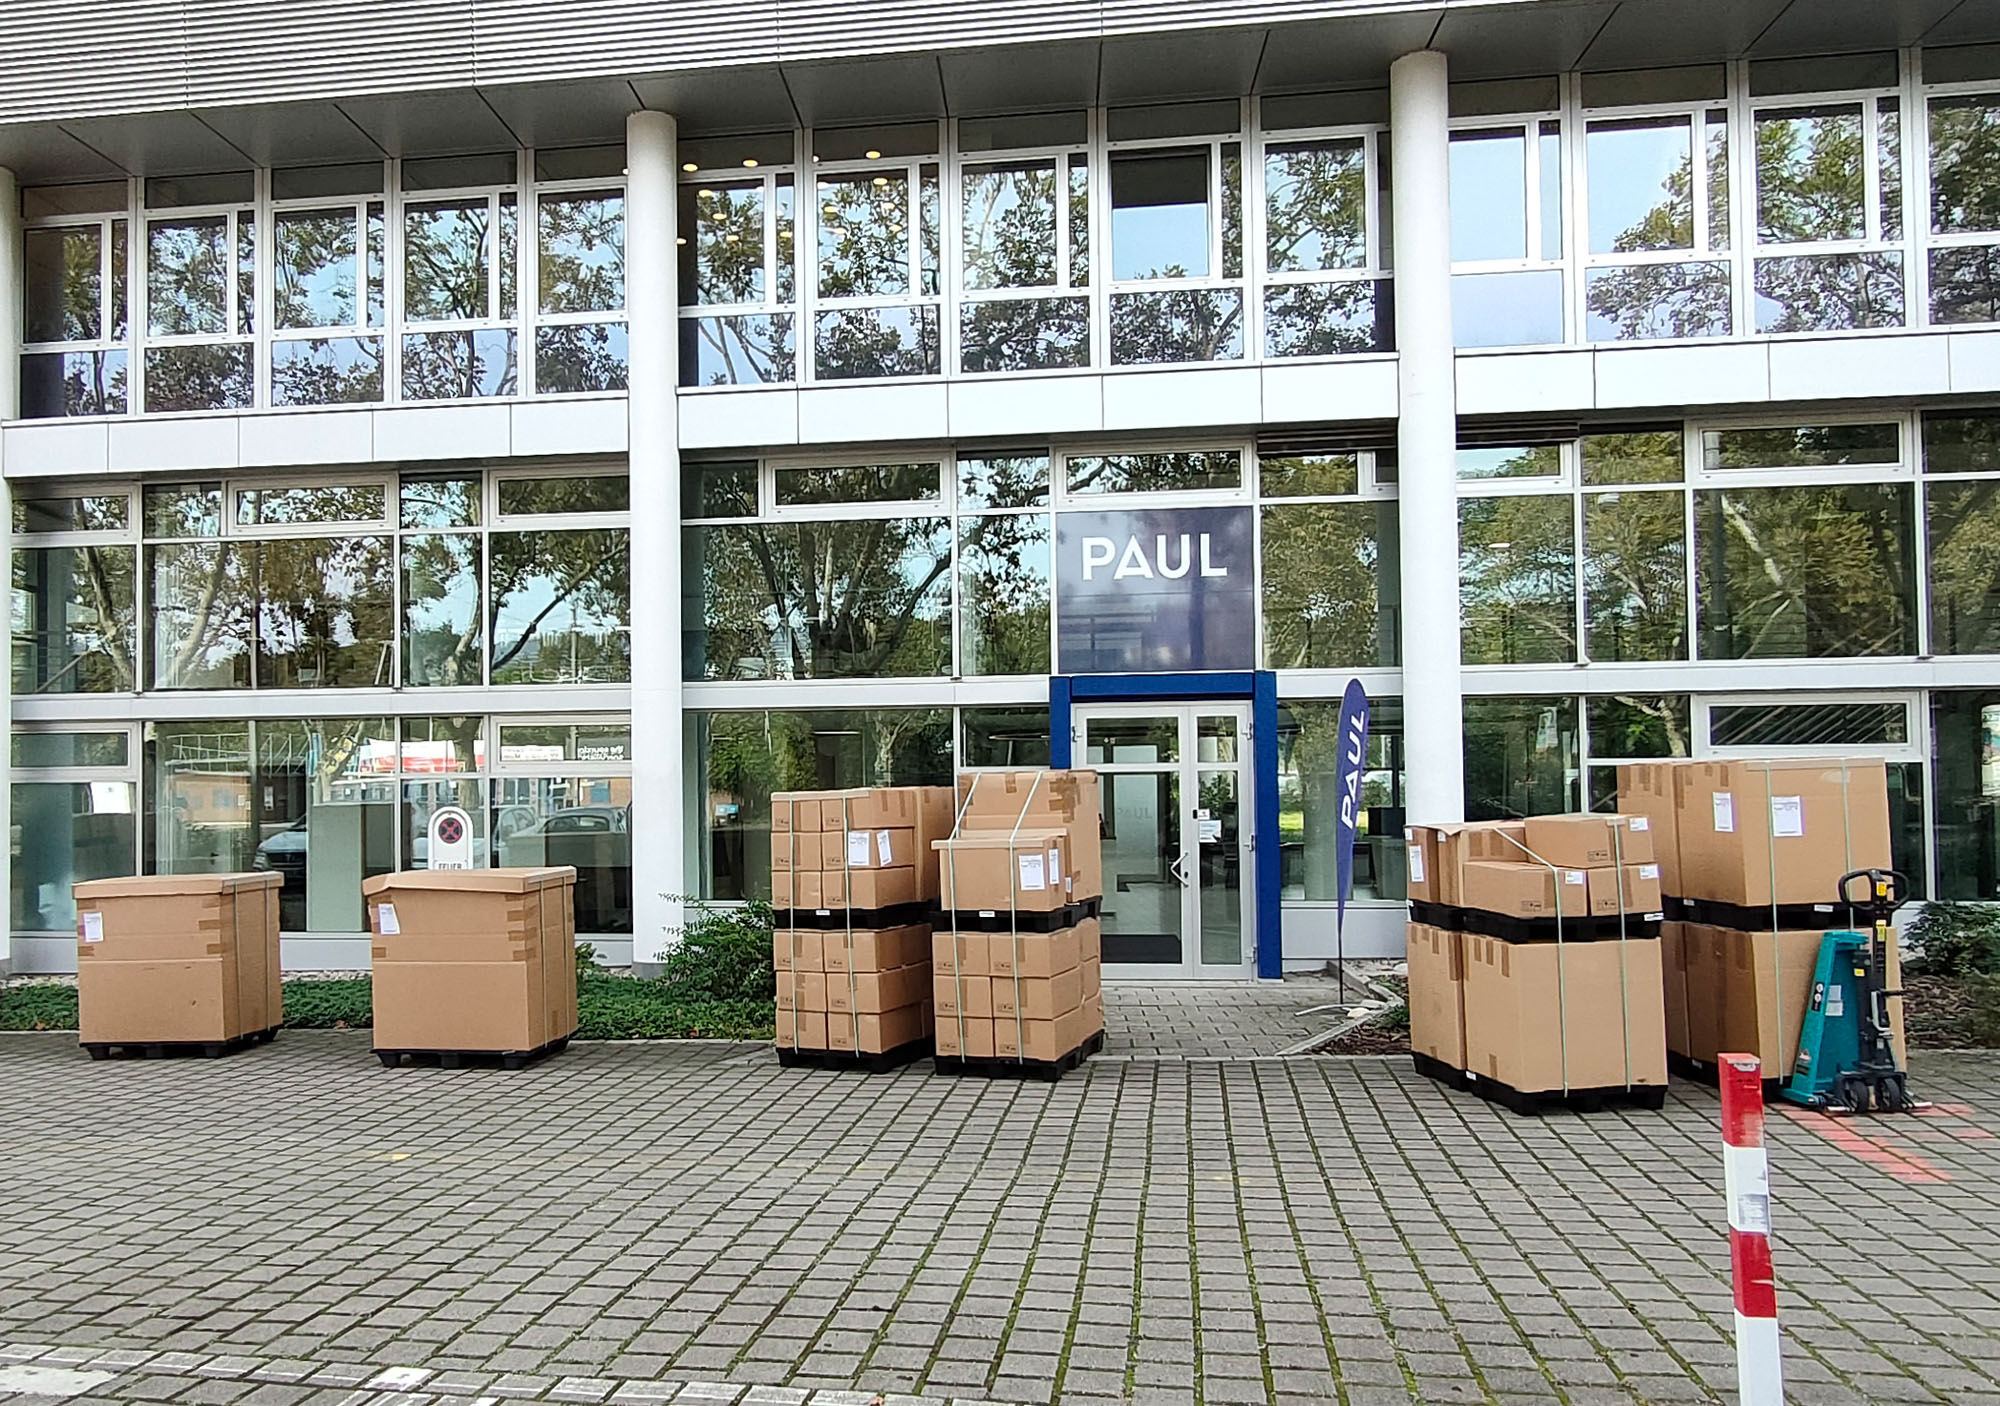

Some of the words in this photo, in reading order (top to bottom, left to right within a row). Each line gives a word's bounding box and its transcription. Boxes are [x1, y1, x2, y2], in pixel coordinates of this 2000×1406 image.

[1082, 533, 1228, 580] PAUL
[1341, 710, 1365, 830] PAUL
[1116, 808, 1153, 819] PAUL
